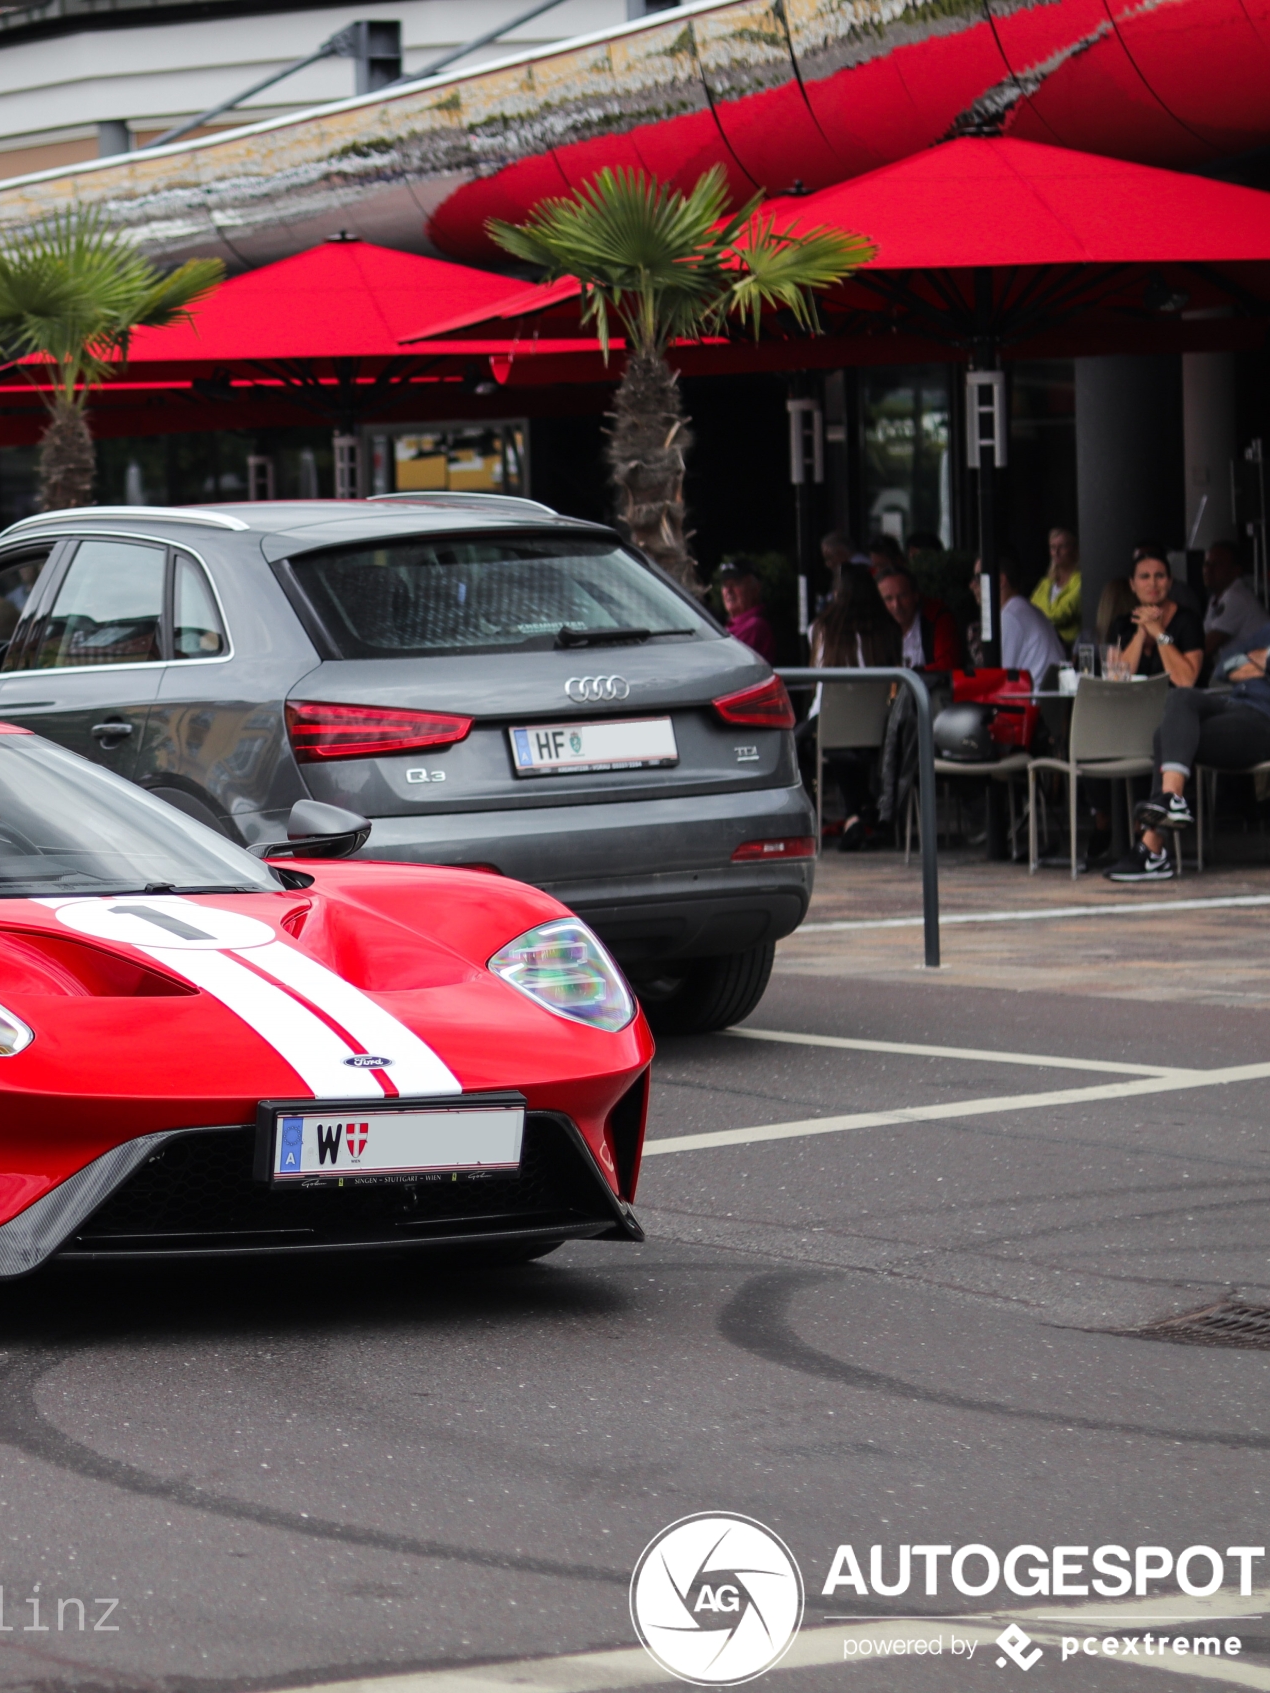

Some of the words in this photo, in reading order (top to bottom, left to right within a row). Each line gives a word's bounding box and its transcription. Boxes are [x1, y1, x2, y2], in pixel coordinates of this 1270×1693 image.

[535, 731, 565, 760] HF
[521, 751, 530, 761] A
[405, 768, 446, 784] Q3
[107, 904, 219, 941] 1
[317, 1123, 342, 1165] W
[285, 1152, 296, 1165] A
[354, 1177, 378, 1185] SINGEN
[384, 1175, 419, 1184] STUTTGART
[425, 1174, 442, 1182] WIEN
